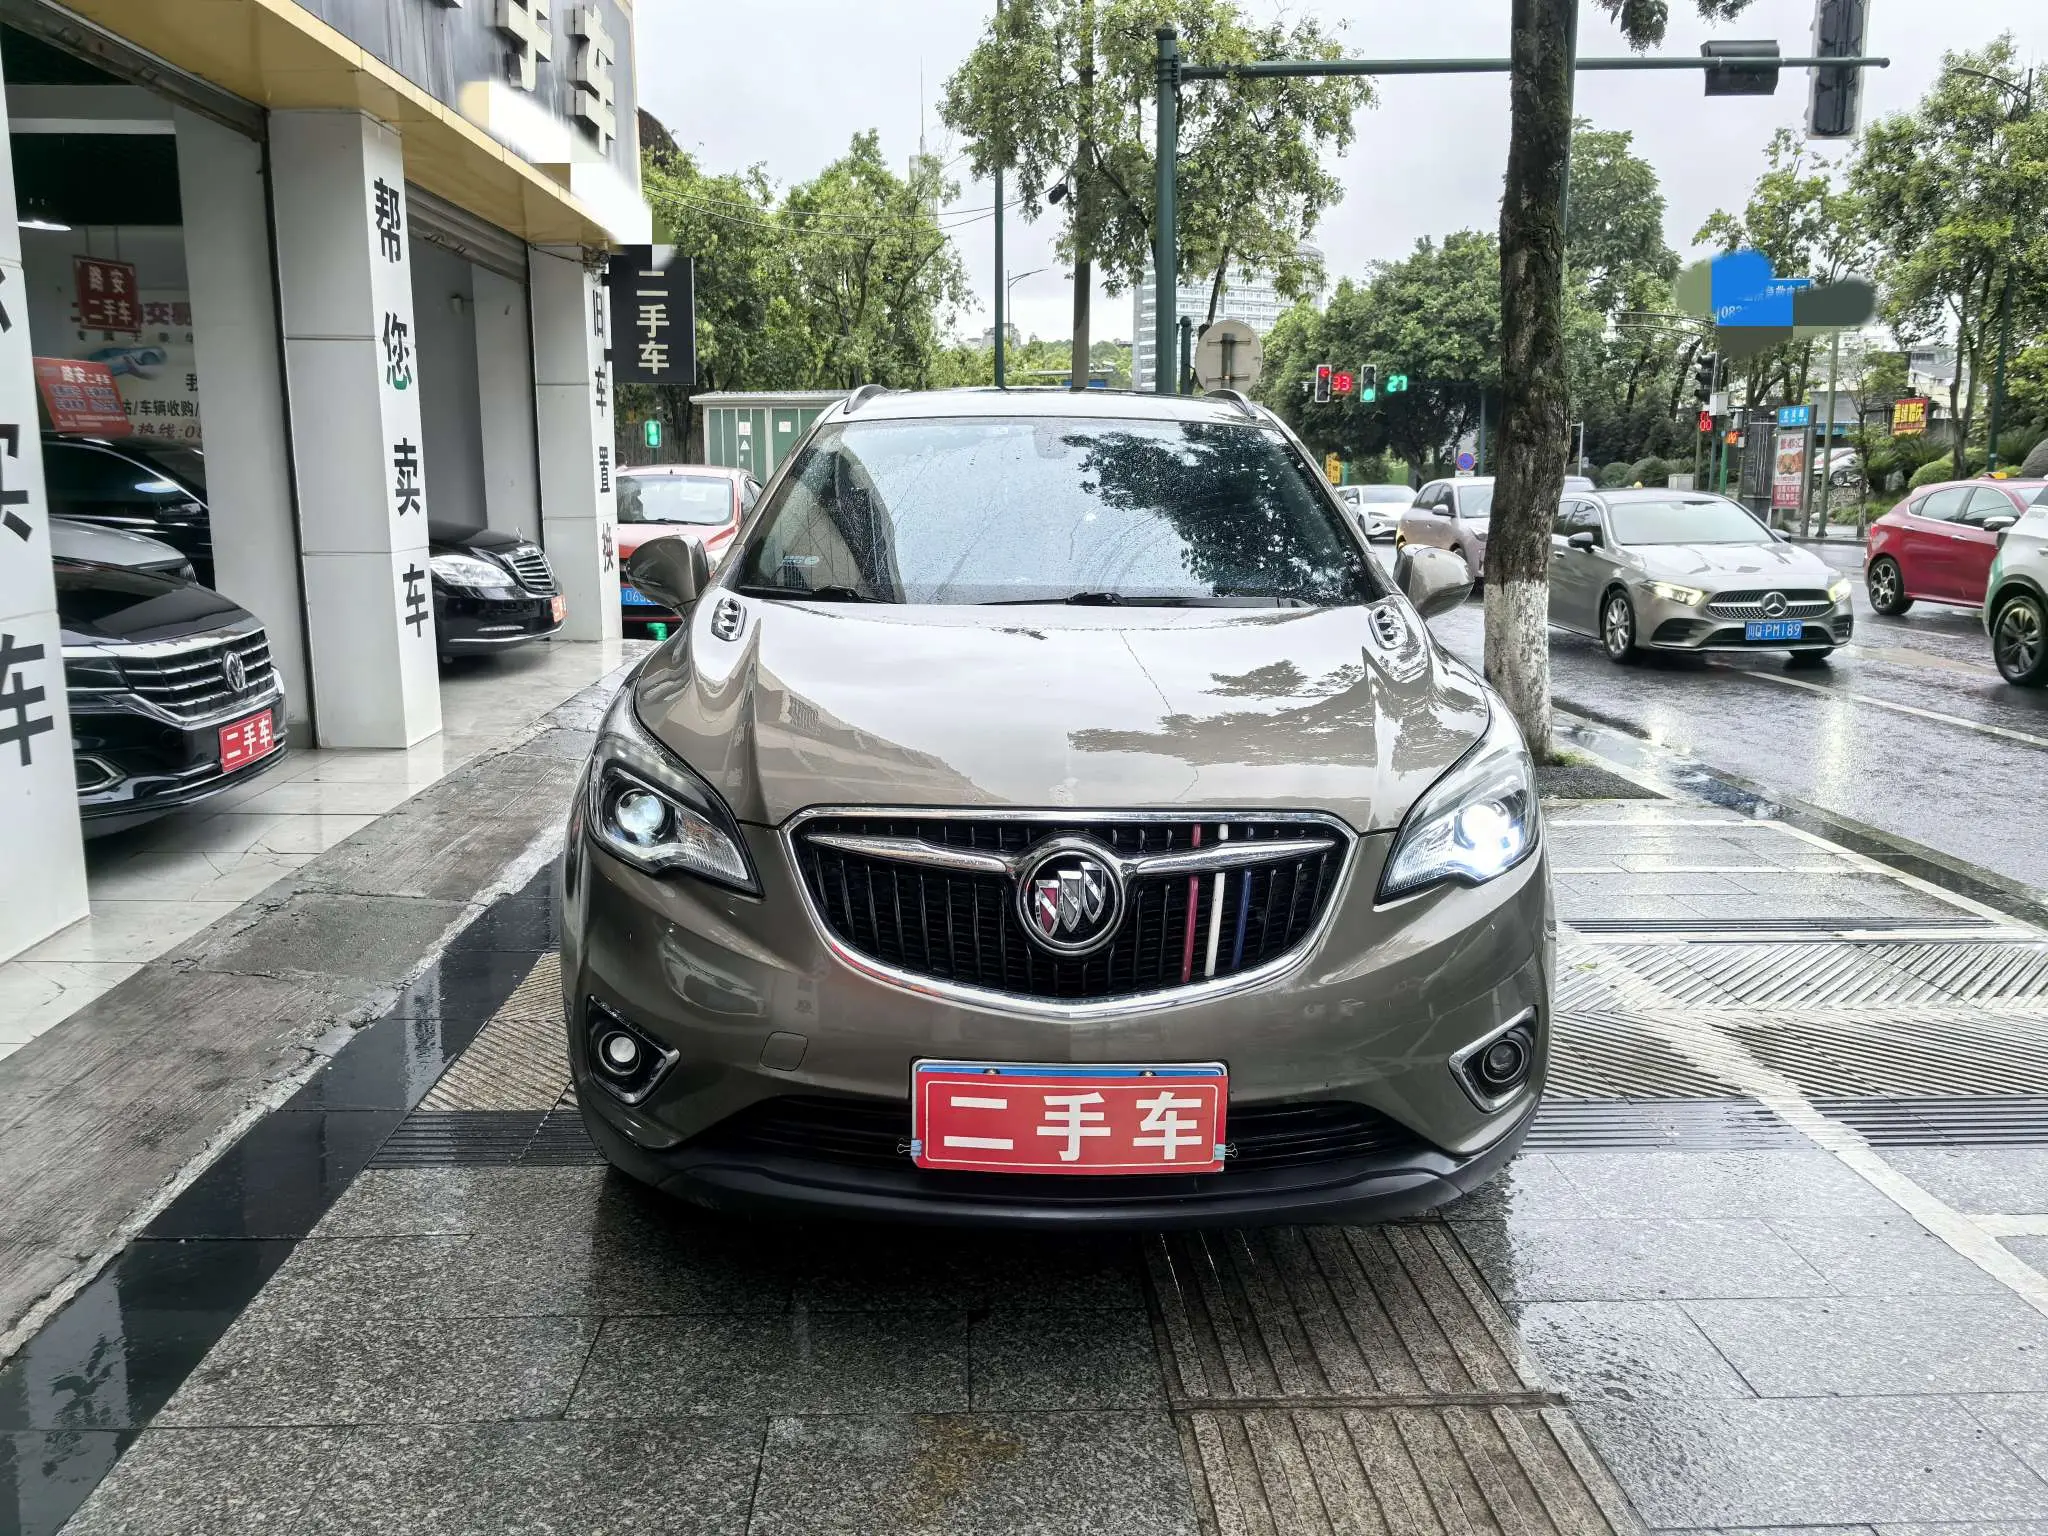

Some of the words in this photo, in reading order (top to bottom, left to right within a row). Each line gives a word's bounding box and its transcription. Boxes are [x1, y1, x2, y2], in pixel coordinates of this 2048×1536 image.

[87, 299, 133, 325] 二手车
[636, 270, 670, 375] 二手车
[373, 176, 429, 639] 帮您卖车
[592, 289, 614, 573] 旧车置换
[226, 718, 272, 759] 二手车
[943, 1091, 1203, 1161] 二手车
